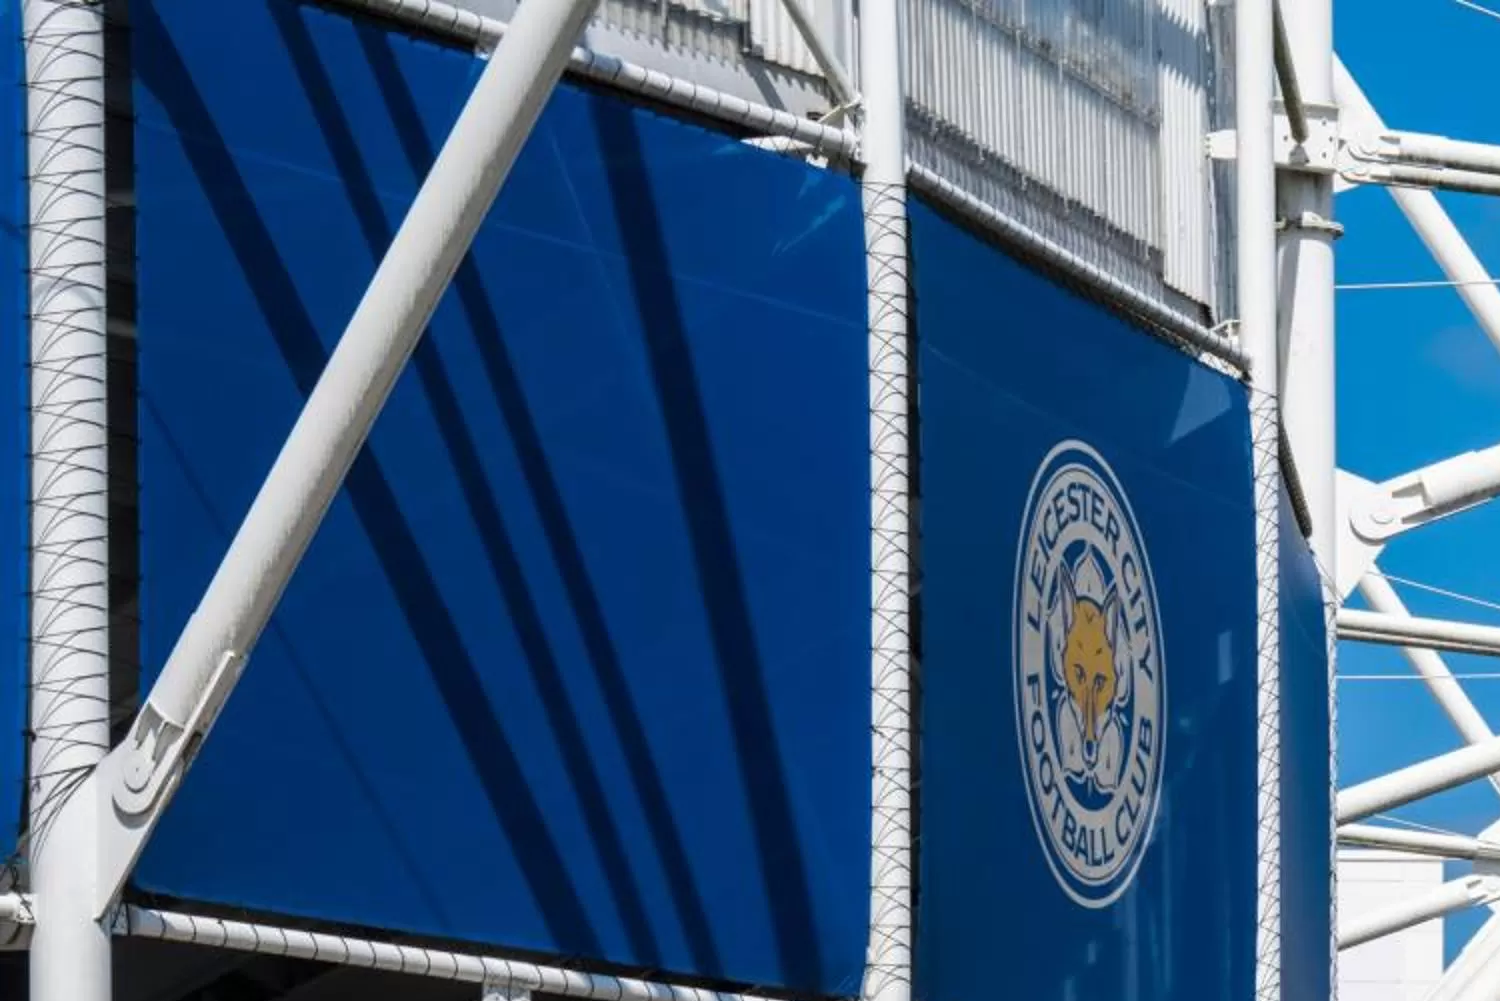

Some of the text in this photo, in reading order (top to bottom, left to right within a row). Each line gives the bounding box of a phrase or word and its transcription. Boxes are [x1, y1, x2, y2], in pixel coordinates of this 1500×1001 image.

[1026, 482, 1154, 684] LEICESTER CITY
[1026, 674, 1154, 866] FOOTBALL CLUB
